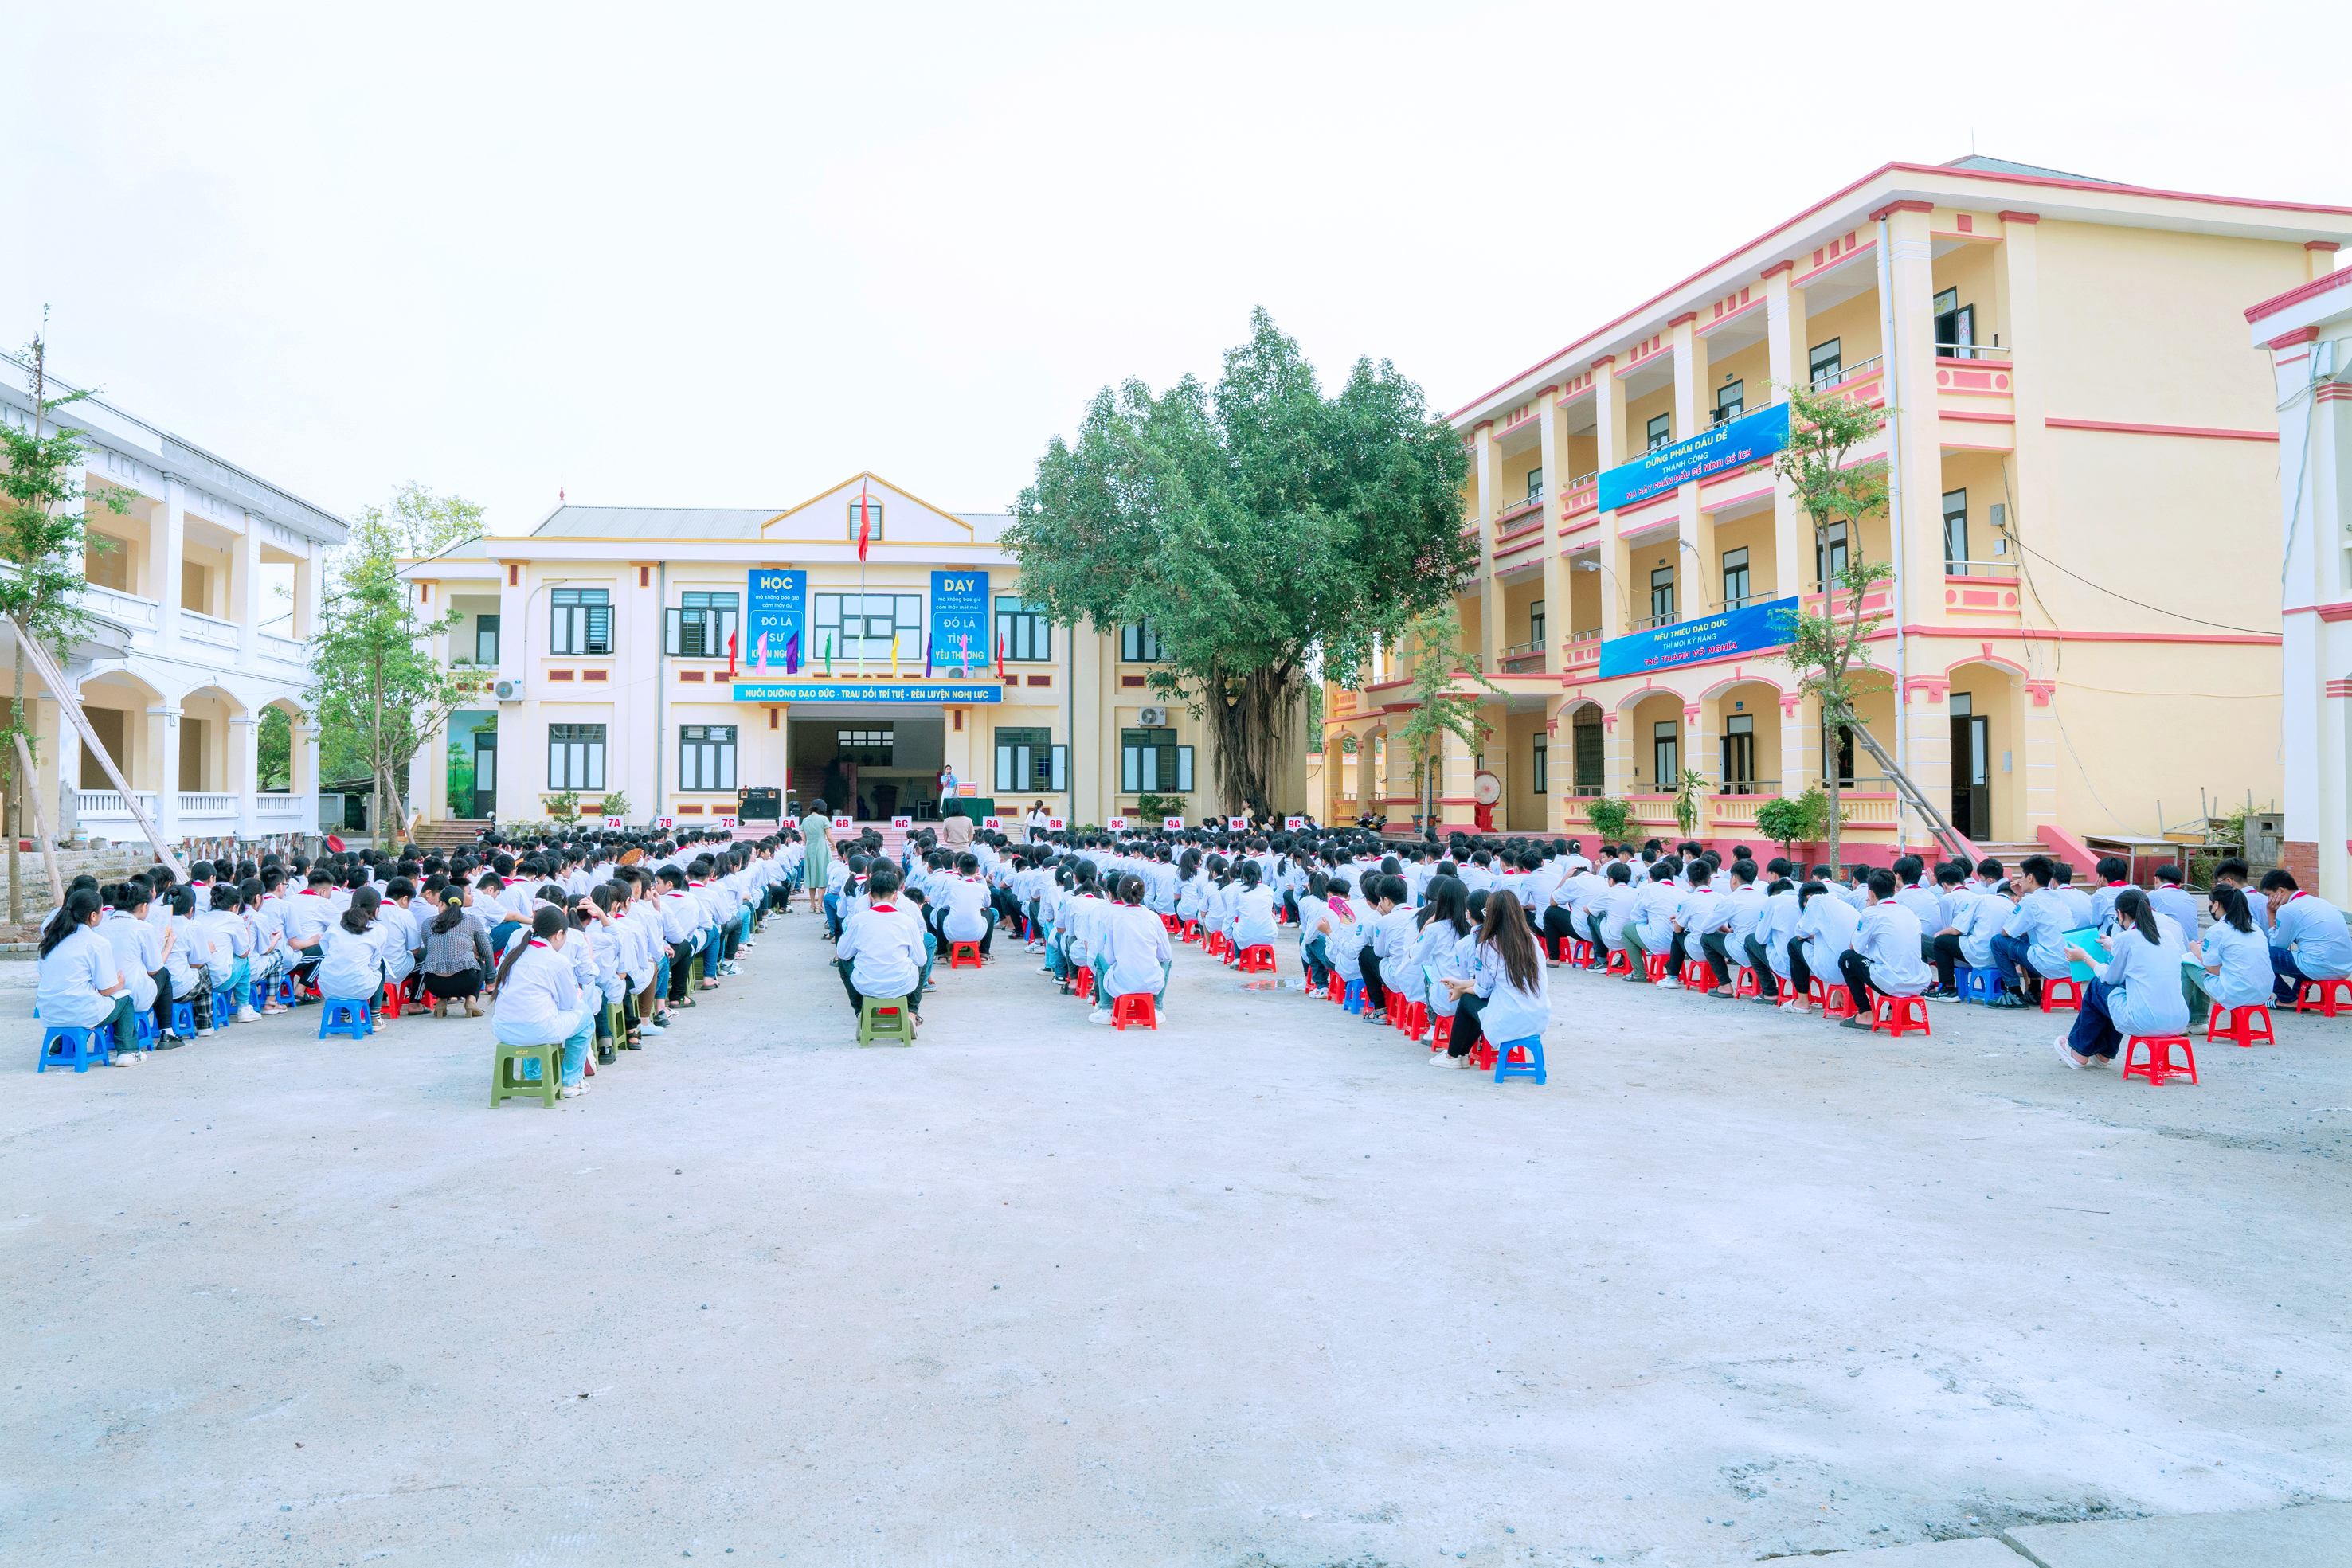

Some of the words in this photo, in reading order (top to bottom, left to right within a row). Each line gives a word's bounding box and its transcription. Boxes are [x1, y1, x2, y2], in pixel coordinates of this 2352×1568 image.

[1670, 442, 1693, 459] PHẤN
[1716, 426, 1728, 442] ĐỂ
[1662, 460, 1686, 473] THÀNH
[1687, 452, 1708, 465] CÔNG
[1626, 489, 1637, 500] MÀ
[1638, 485, 1652, 495] HÃY
[1653, 475, 1673, 490] PHẤN
[1674, 469, 1690, 483] ĐẤU
[1692, 462, 1702, 477] ĐỂ
[1703, 459, 1723, 472] MÌNH
[1725, 452, 1736, 465] CÓ
[1738, 448, 1752, 461] ÍCH
[761, 577, 793, 593] HỌC
[944, 579, 975, 595] DẠY
[761, 614, 777, 626] ĐÓ
[781, 614, 792, 626] LÀ
[944, 616, 960, 628] ĐÓ
[963, 616, 975, 628] LÀ
[1670, 625, 1691, 637] THIẾU
[1692, 624, 1709, 634] ĐẠO
[1711, 618, 1728, 629] ĐỨC
[769, 632, 785, 645] SỰ
[1663, 641, 1672, 650] THÌ
[1674, 640, 1686, 648] MỌI
[1687, 637, 1696, 645] KỸ
[1698, 633, 1716, 643] NĂNG
[936, 649, 949, 660] YÊU
[1644, 655, 1659, 666] TRỞ
[1661, 651, 1690, 663] THÀNH
[1693, 647, 1705, 657] VÔ
[1708, 641, 1737, 654] NGHĨA
[745, 688, 765, 697] NUÔI
[767, 688, 796, 698] DƯỠNG
[798, 690, 816, 700] ĐẠO
[818, 688, 835, 698] ĐỨC
[879, 689, 890, 698] TRÍ
[892, 689, 904, 700] TUỆ
[911, 689, 925, 698] RÈN
[927, 689, 950, 700] LUYỆN
[952, 691, 972, 700] NGHỊ
[974, 690, 989, 700] LỰC
